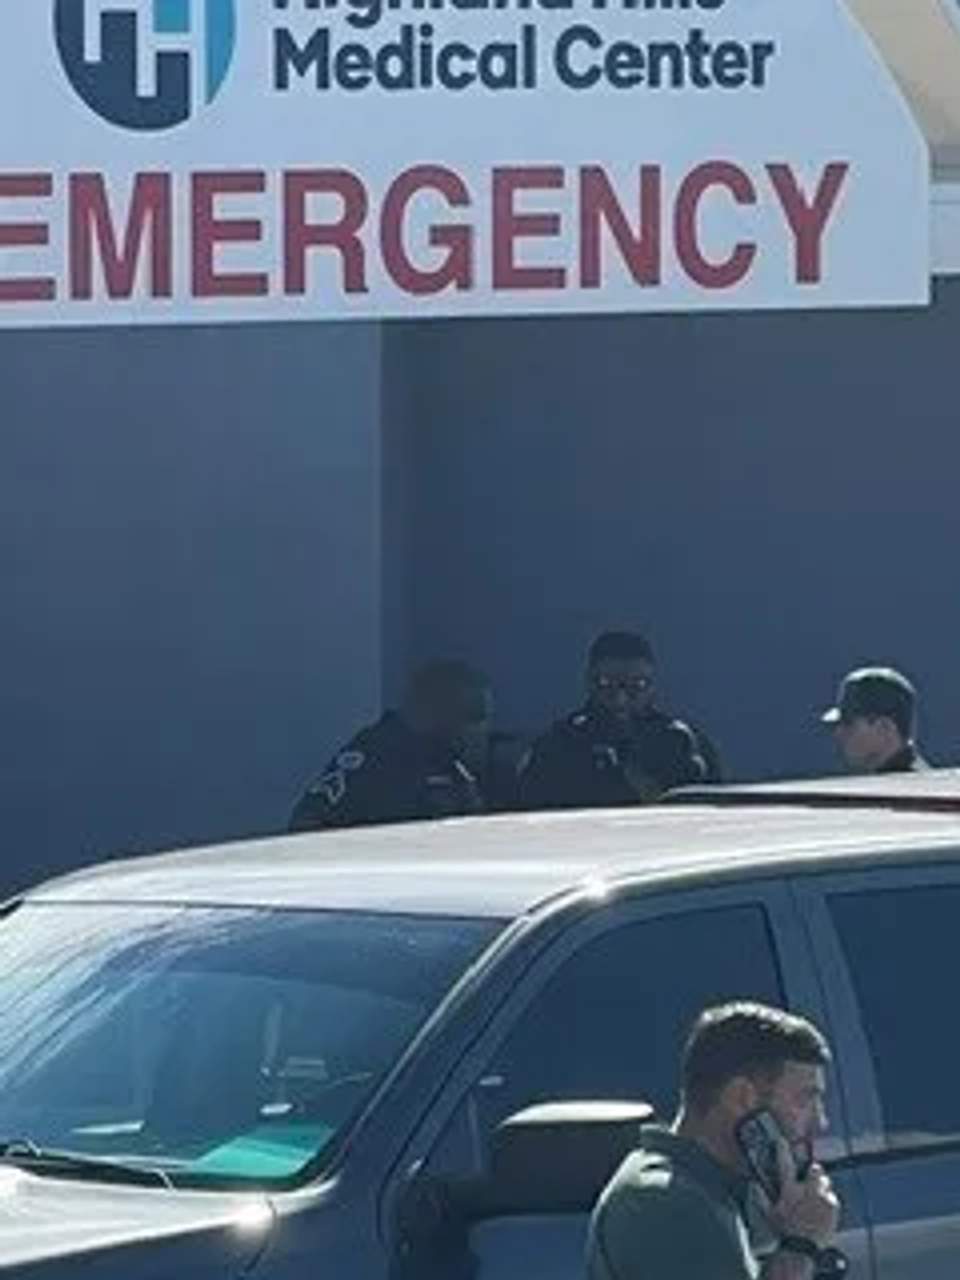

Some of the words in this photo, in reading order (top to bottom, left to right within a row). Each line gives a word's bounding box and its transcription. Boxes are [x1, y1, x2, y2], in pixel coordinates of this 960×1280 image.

[273, 26, 535, 91] Medical
[554, 25, 774, 89] Center
[0, 160, 850, 303] EMERGENCY
